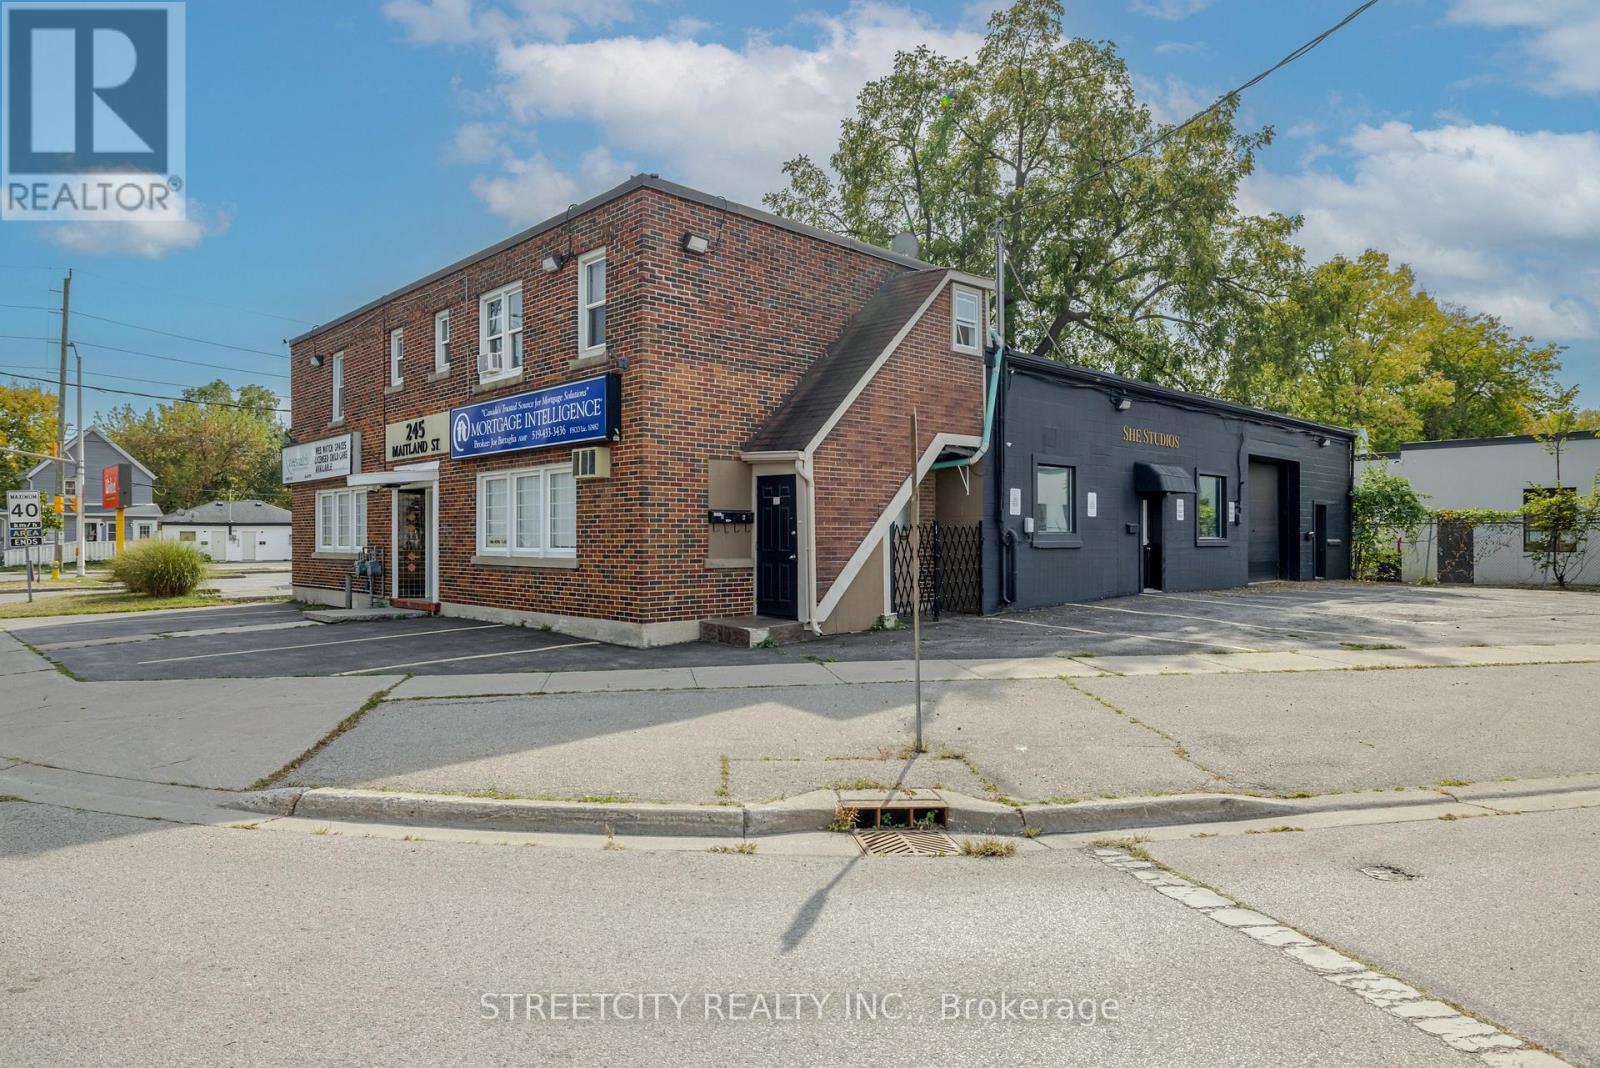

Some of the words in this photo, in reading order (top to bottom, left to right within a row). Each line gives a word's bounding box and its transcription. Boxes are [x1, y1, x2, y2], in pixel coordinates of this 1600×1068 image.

[518, 400, 534, 410] Source
[406, 419, 425, 441] 245
[471, 413, 522, 437] MORTGAGE
[490, 437, 498, 448] Joe
[392, 440, 428, 458] MAITLAND
[339, 450, 348, 460] CARE
[11, 503, 38, 518] 40
[12, 529, 39, 537] AREA
[14, 538, 38, 546] ENDS
